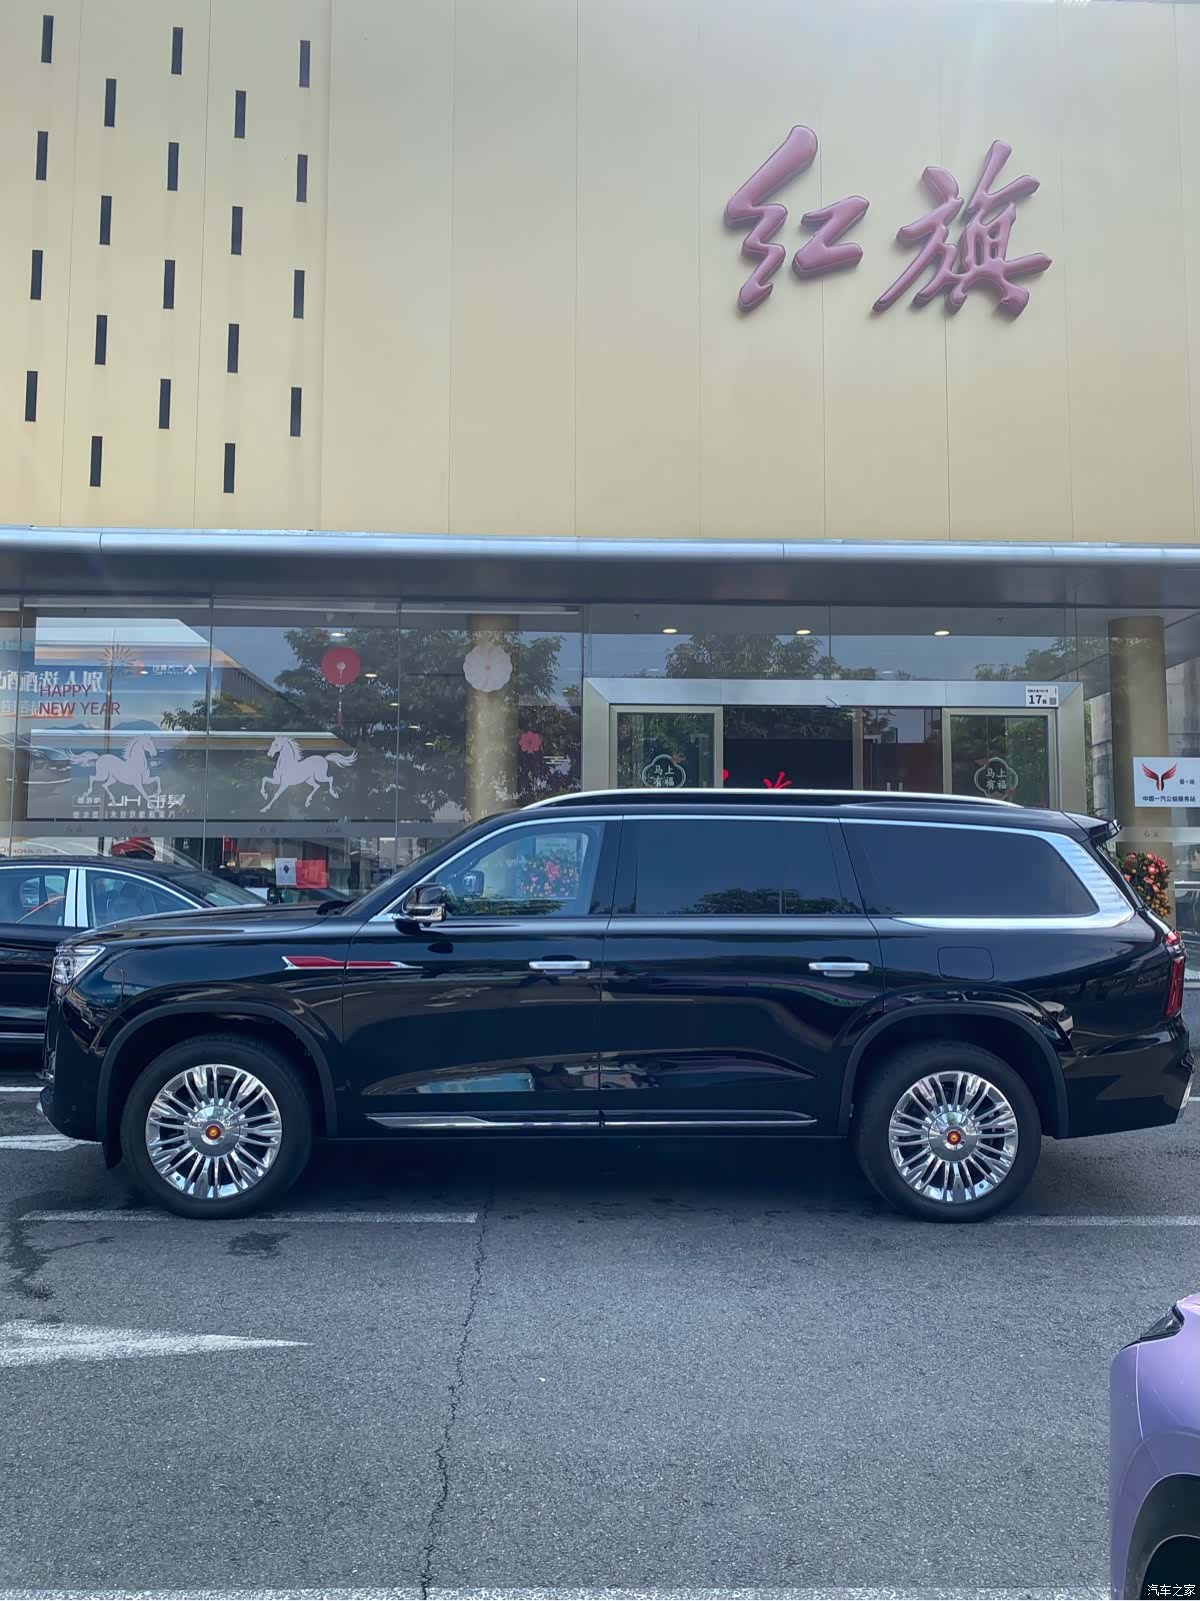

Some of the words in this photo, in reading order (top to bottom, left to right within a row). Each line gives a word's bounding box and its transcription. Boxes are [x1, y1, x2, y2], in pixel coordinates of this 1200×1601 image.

[723, 124, 1053, 319] 红旗
[39, 684, 92, 698] HAPPY
[39, 702, 76, 716] NEW
[81, 702, 121, 716] YEAR
[653, 764, 675, 776] 马上
[985, 767, 1007, 779] 马上
[985, 779, 1008, 791] 有福
